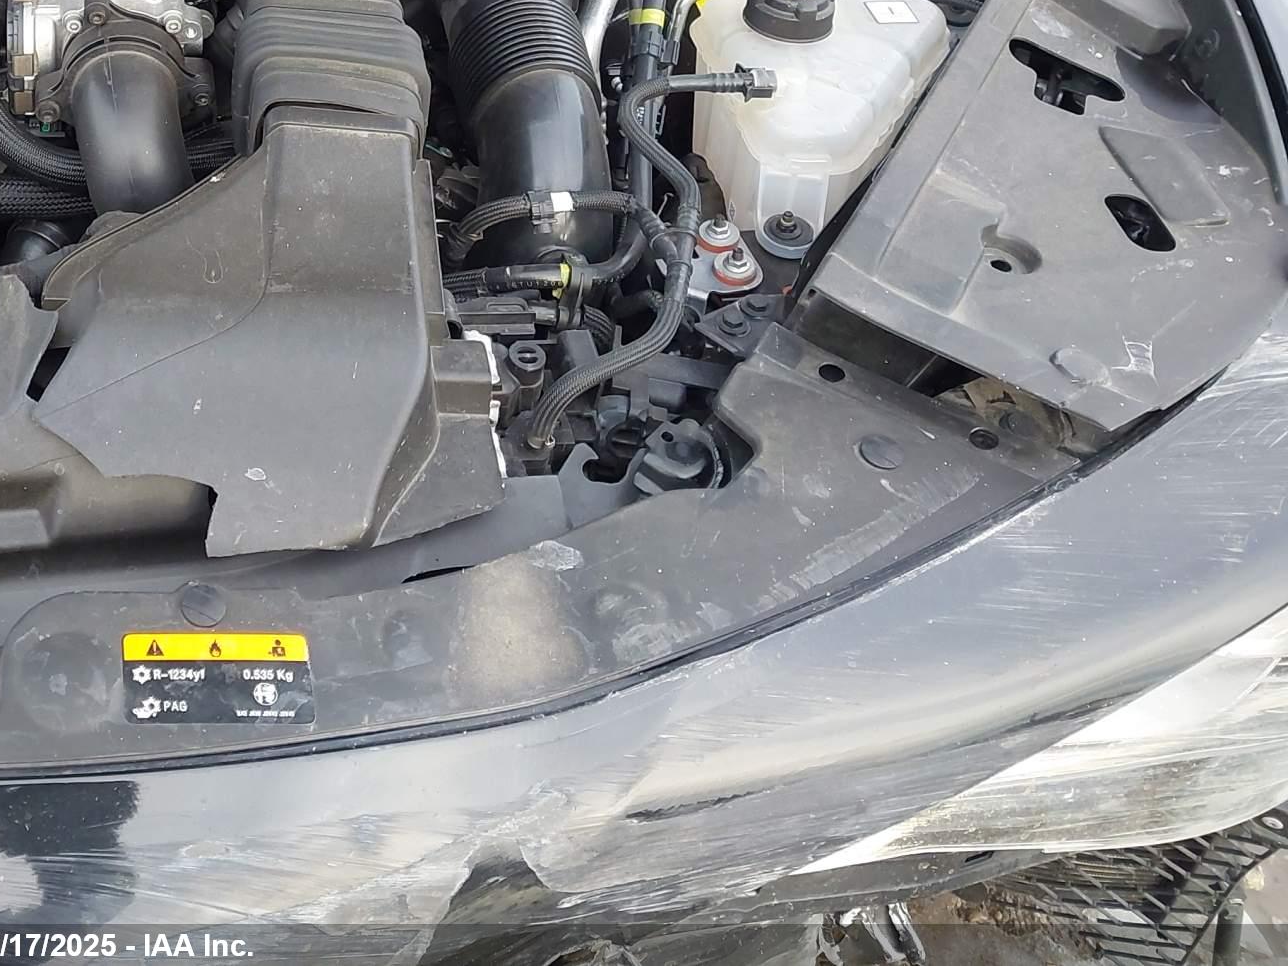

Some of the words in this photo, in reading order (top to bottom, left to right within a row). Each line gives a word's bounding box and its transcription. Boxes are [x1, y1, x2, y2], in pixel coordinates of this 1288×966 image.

[153, 669, 206, 683] R-1234yf
[242, 669, 274, 681] 0.535
[276, 669, 294, 684] Kg
[163, 700, 188, 713] PAG
